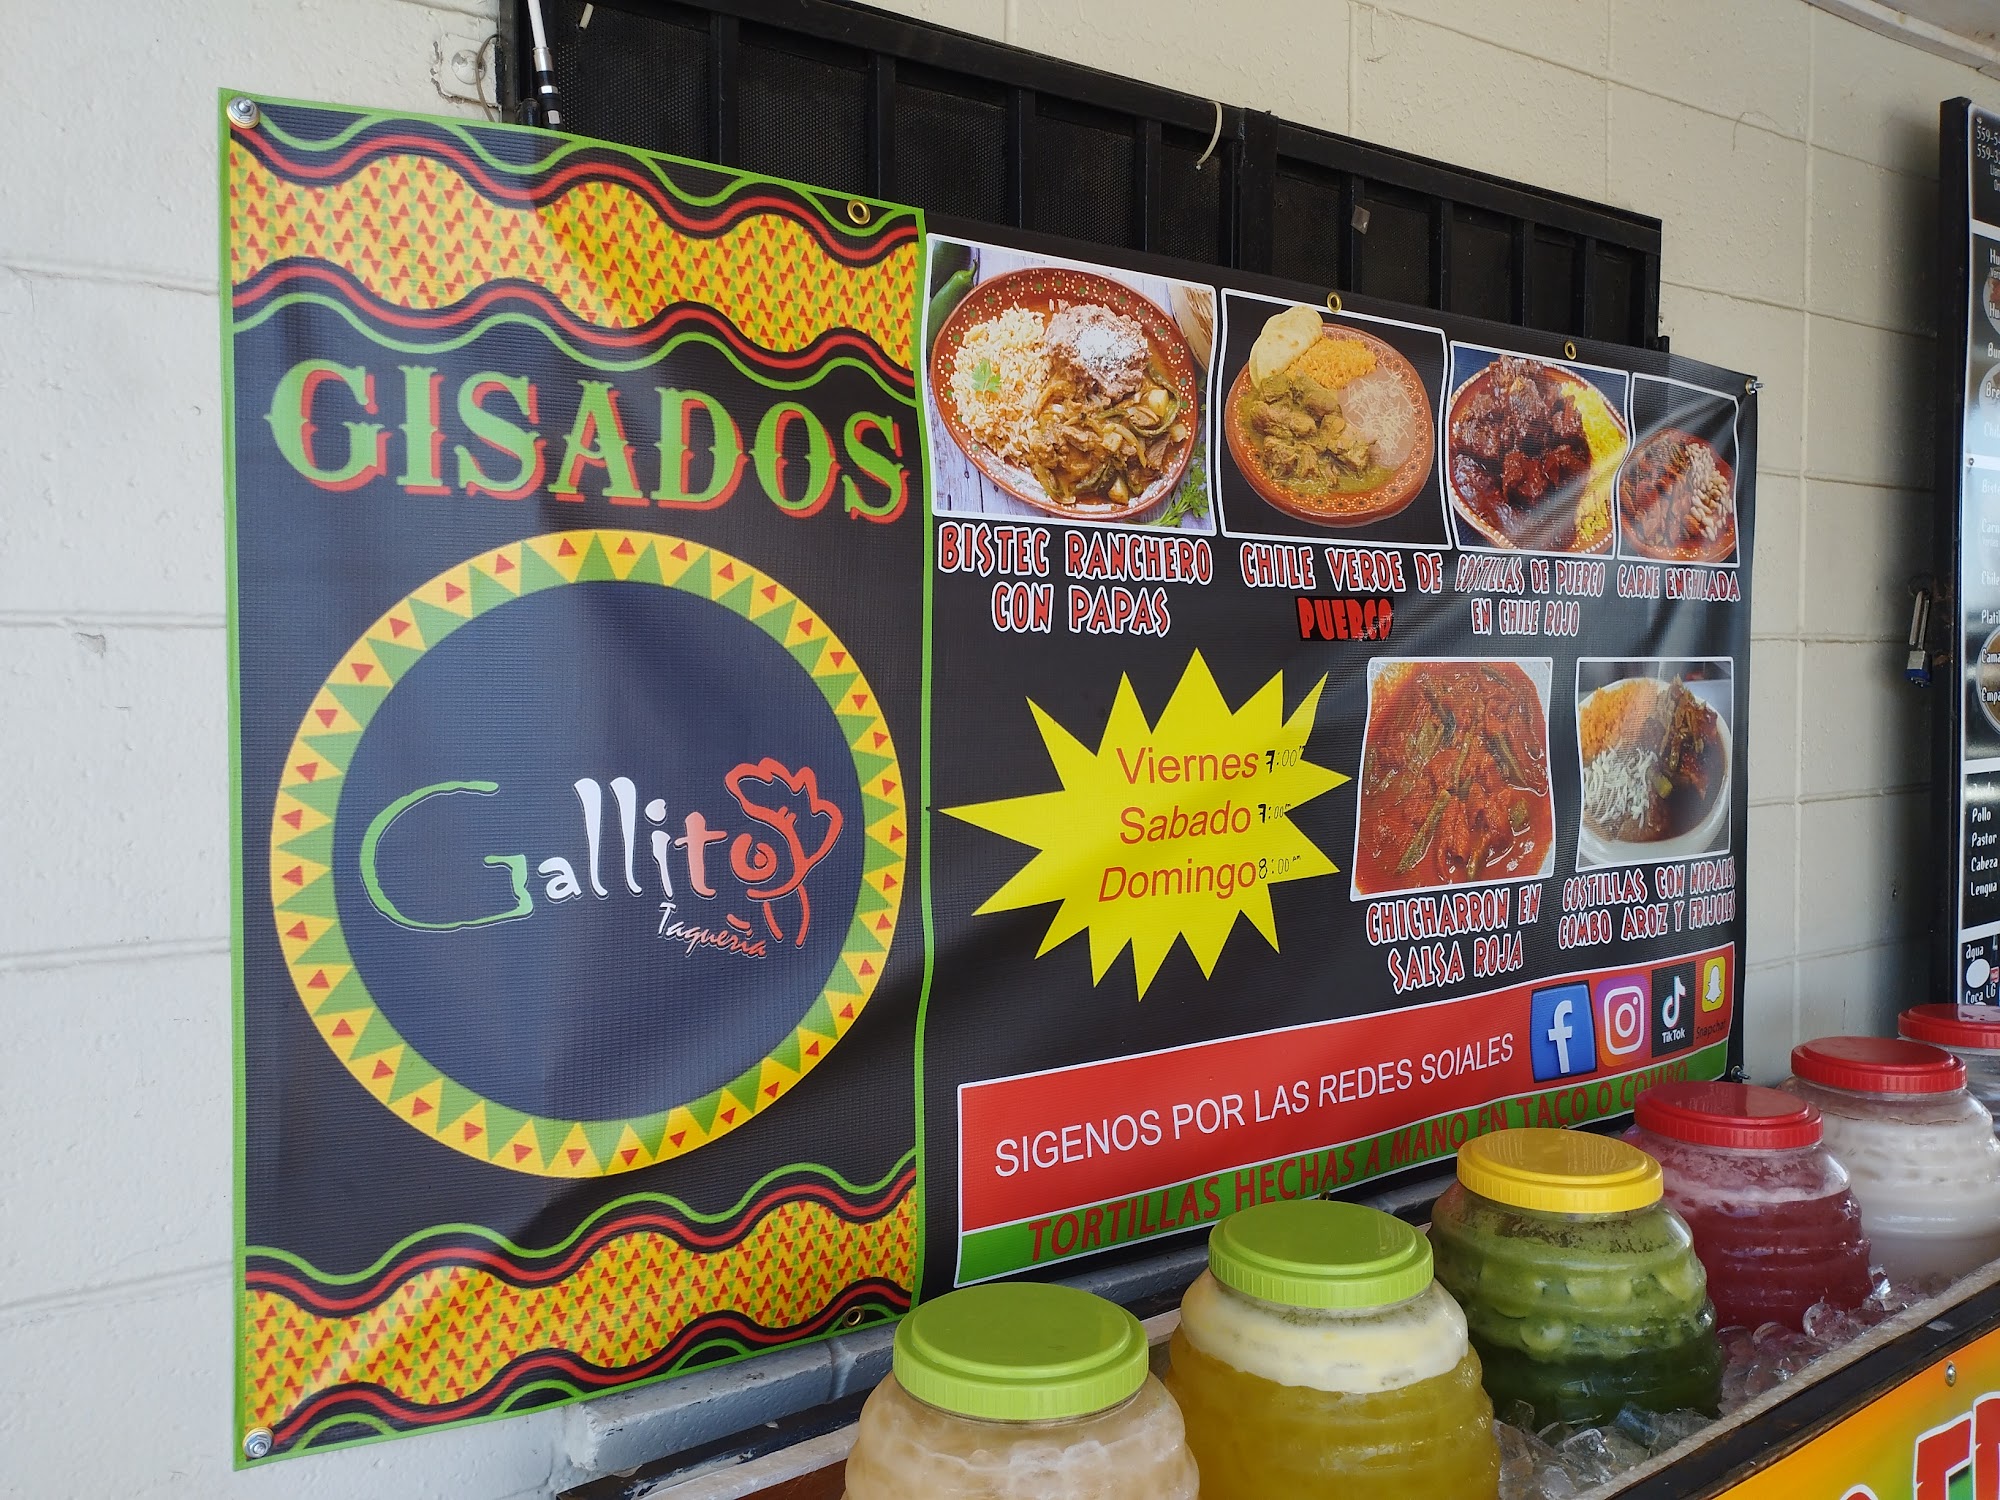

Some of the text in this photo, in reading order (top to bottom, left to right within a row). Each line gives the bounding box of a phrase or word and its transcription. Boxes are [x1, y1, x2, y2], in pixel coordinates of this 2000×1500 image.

[263, 358, 909, 523] GISADOS
[938, 521, 1213, 585] BISTEC RANCHERO
[1240, 541, 1443, 593] CHILE VERDE DE
[1454, 553, 1606, 599] COSTILLAS DE PUERCO
[1616, 563, 1741, 602] CARNE ENCHILADA
[991, 581, 1171, 638] CON PAPAS
[1471, 598, 1580, 637] EN CHILE ROJO
[1116, 747, 1298, 785] Viernes 7:00
[1119, 800, 1252, 845] Sabado
[1257, 803, 1285, 824] 7:00
[1971, 806, 1992, 824] Pollo
[1971, 832, 1998, 848] Pastor
[1098, 858, 1257, 903] Domingo
[1258, 858, 1290, 880] 8:00
[1562, 856, 1736, 912] COSTILLAS CON NOPALES
[1970, 856, 1998, 873] Cabeza
[1970, 881, 1998, 898] Lengua
[1366, 884, 1542, 946] CHICHARRON EN
[1558, 907, 1612, 950] COMBO
[1621, 902, 1668, 941] AROZ
[1673, 900, 1685, 932] Y
[1388, 930, 1523, 994] SALSA ROJA
[1662, 1027, 1686, 1044] TikTok
[994, 1032, 1514, 1178] SIGENOS POR LAS REDES SOIALES
[1028, 1176, 1222, 1262] TORTILLAS
[1234, 1144, 1356, 1214] HECHAS
[1363, 1139, 1381, 1177] A
[1389, 1113, 1468, 1169] MANO
[1516, 1087, 1589, 1131] TACO
[1596, 1079, 1613, 1116] O
